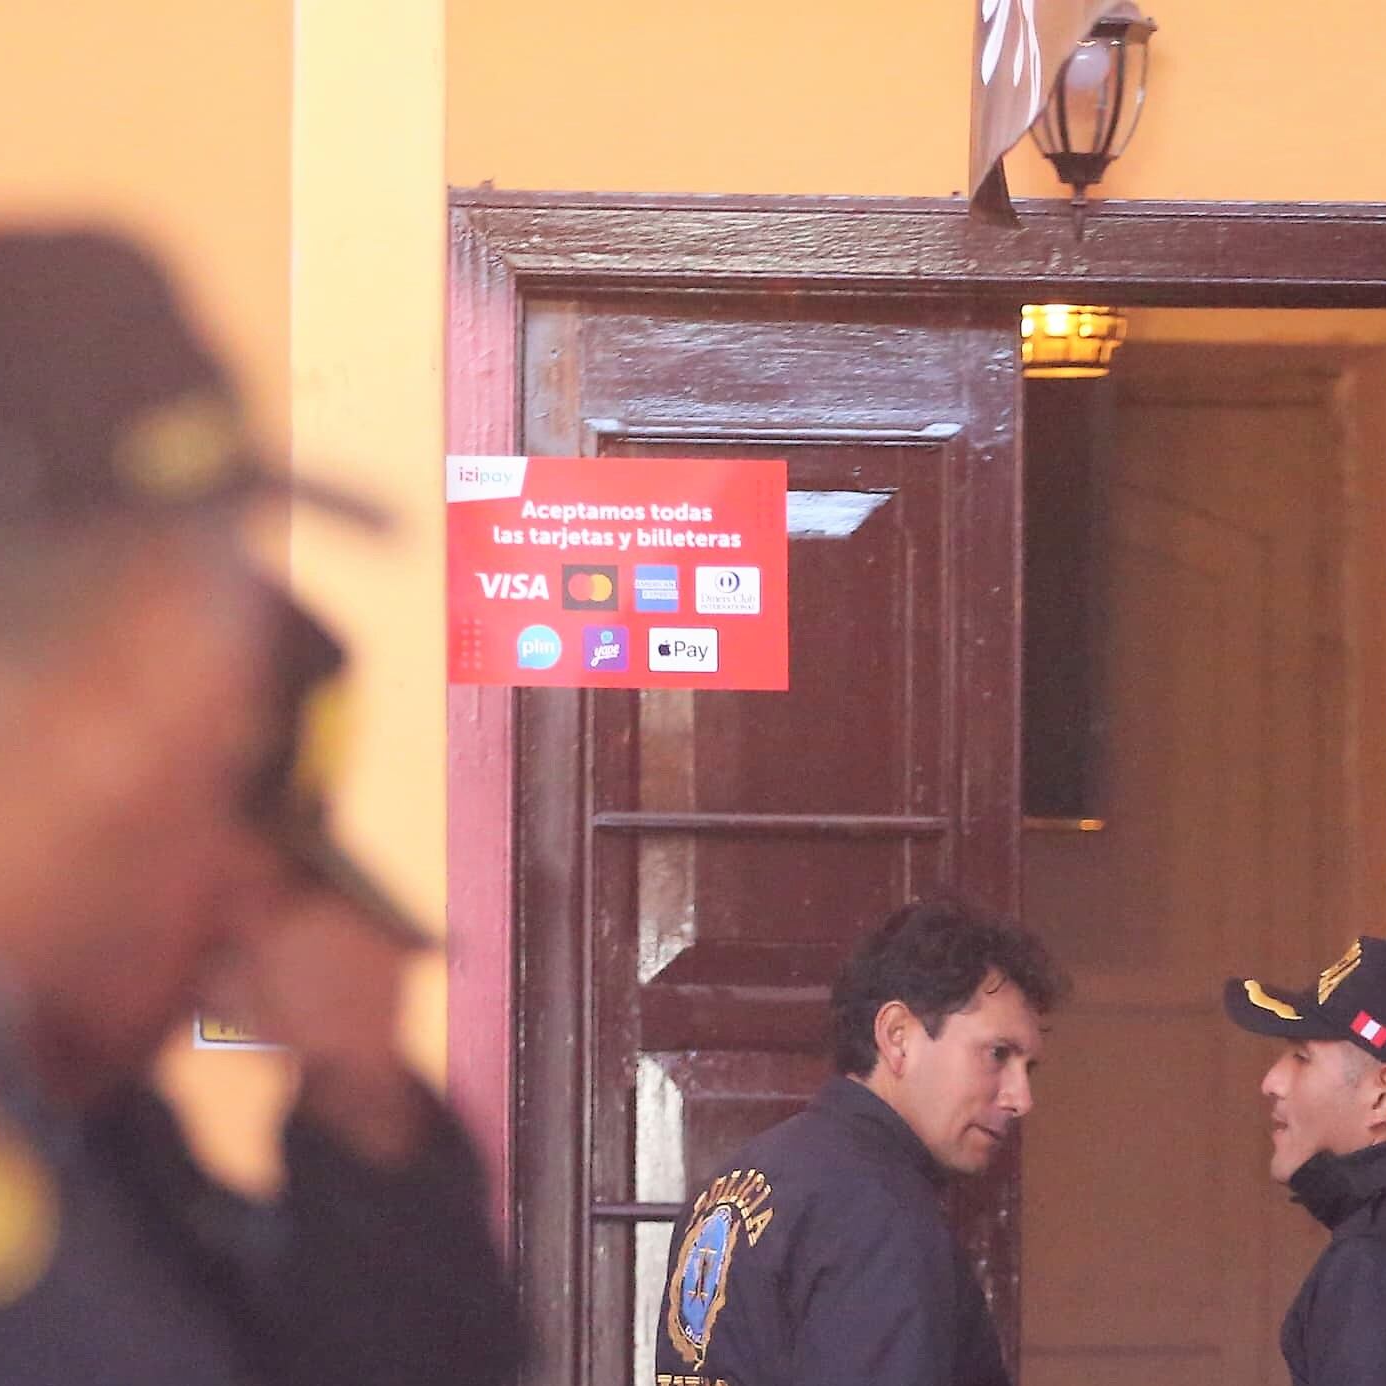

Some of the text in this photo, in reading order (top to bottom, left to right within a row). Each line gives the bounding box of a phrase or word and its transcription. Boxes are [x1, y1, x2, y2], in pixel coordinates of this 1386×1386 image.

[459, 467, 513, 485] izipay
[521, 500, 713, 523] Aceptamos todas
[493, 526, 742, 550] las tarjetas y billeteras
[475, 572, 549, 600] VISA
[522, 640, 554, 657] plin
[674, 640, 709, 661] Pay
